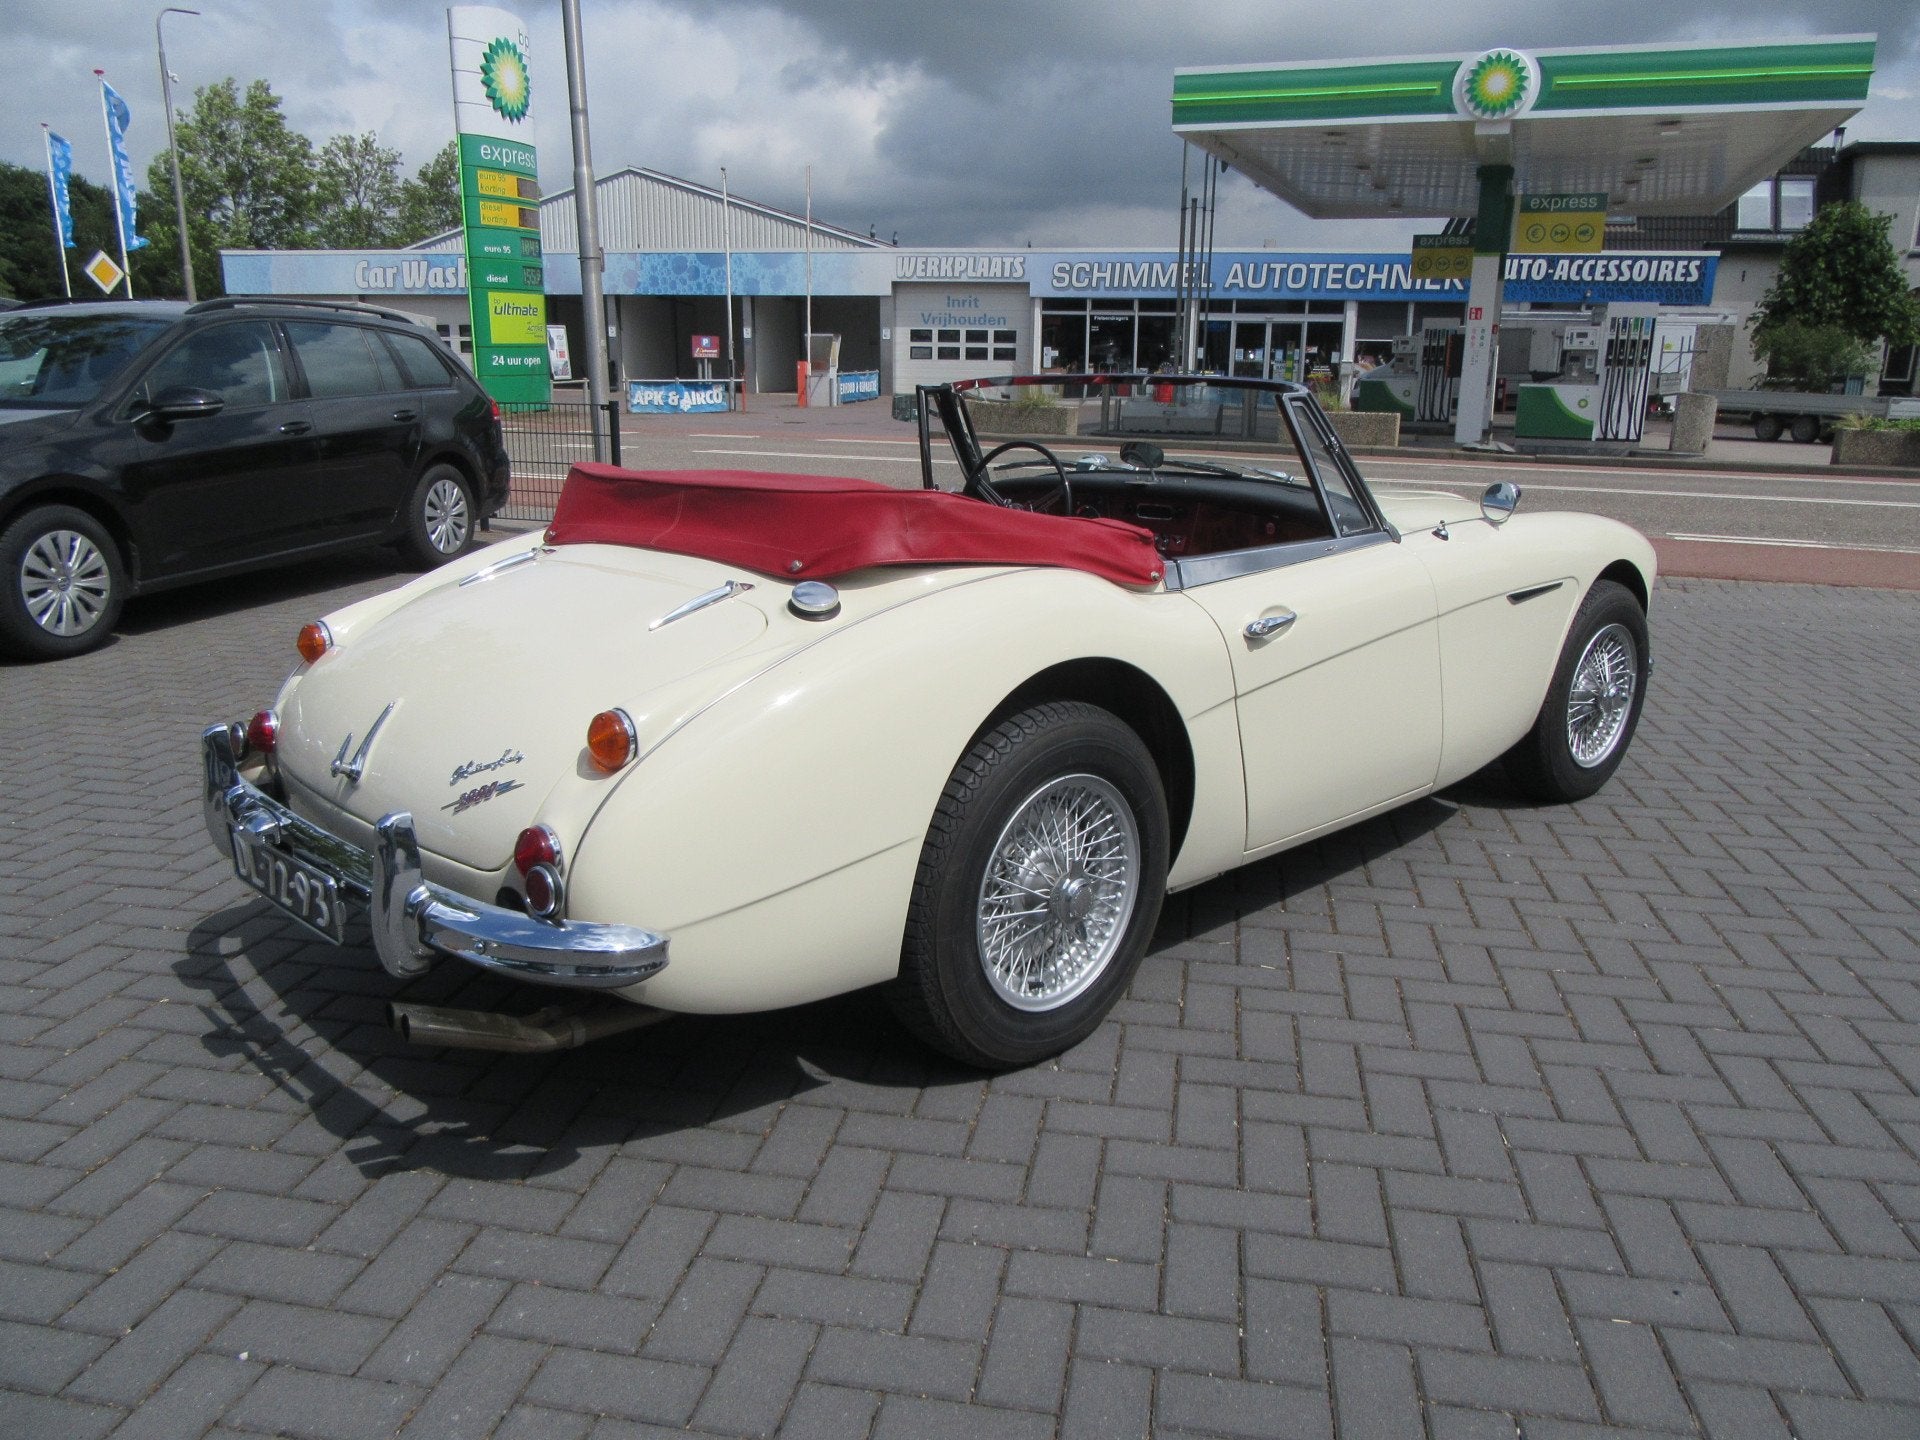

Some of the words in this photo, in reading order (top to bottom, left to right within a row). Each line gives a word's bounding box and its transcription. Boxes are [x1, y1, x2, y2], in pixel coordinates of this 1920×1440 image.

[517, 28, 530, 52] bp
[480, 144, 536, 169] express
[478, 172, 497, 181] euro
[479, 182, 506, 195] korting
[480, 202, 503, 212] diesel
[1529, 196, 1598, 212] express
[481, 214, 508, 225] korting
[1419, 234, 1470, 247] express
[484, 245, 502, 254] euro
[502, 245, 511, 254] 95
[355, 260, 398, 289] Car
[401, 257, 469, 289] Wash
[896, 256, 1025, 279] WERKPLAATS
[1051, 262, 1213, 289] SCHIMMEL
[1504, 258, 1701, 283] UTO-ACCESSOIRES
[486, 274, 508, 284] diesel
[494, 302, 538, 316] ultimate
[946, 295, 980, 309] Inrit
[921, 312, 1007, 328] Vrijhouden
[492, 355, 505, 366] 24
[507, 356, 522, 365] uur
[523, 356, 541, 367] open
[633, 390, 665, 406] APK
[668, 390, 680, 406] &
[682, 386, 724, 406] AIRCO
